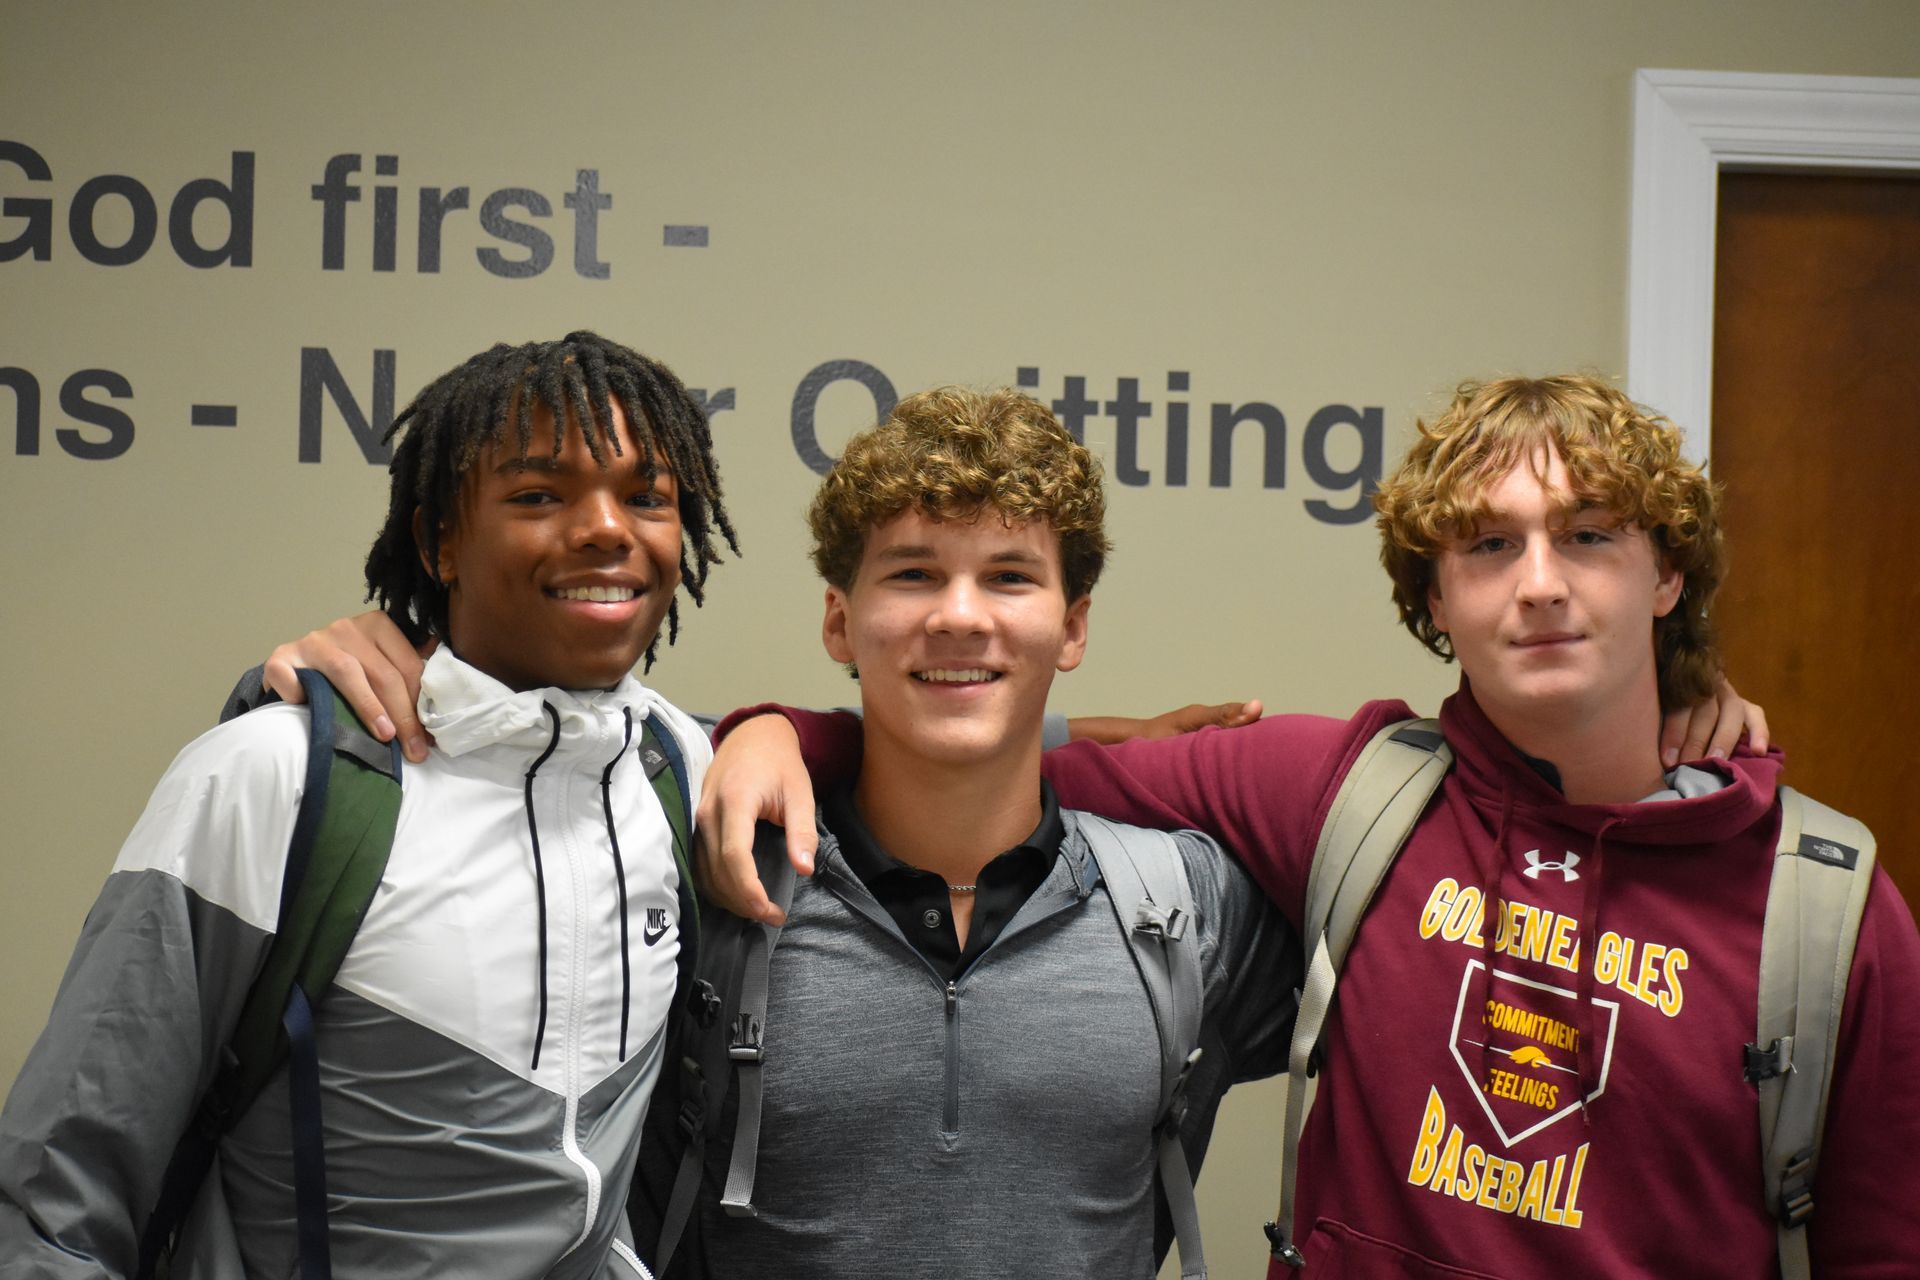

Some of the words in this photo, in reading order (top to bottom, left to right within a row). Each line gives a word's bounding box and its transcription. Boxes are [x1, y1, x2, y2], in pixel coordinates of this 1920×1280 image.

[0, 140, 256, 269] God
[311, 153, 613, 280] first
[790, 358, 1384, 525] Qtting
[646, 907, 666, 930] NIKE
[1407, 1083, 1590, 1229] BASEBALL
